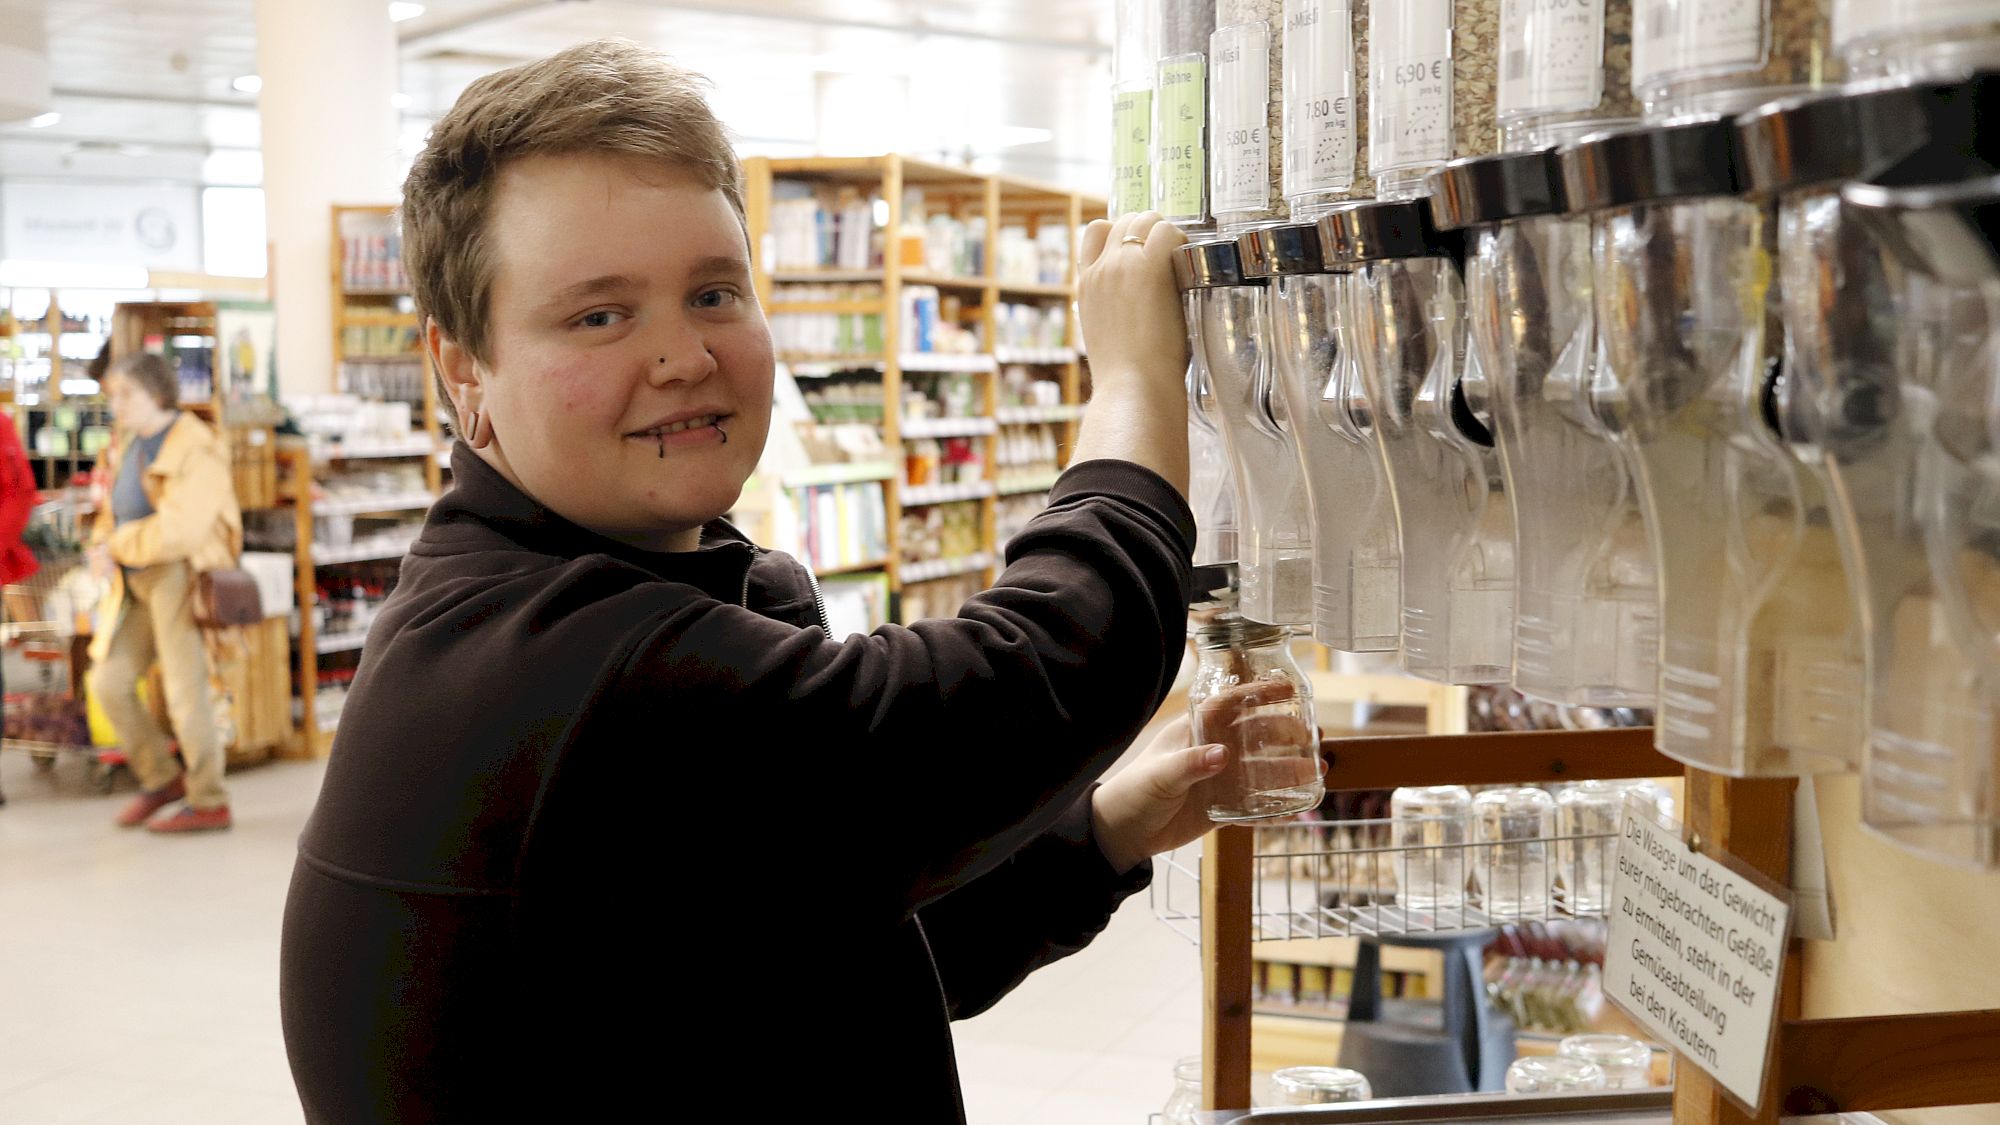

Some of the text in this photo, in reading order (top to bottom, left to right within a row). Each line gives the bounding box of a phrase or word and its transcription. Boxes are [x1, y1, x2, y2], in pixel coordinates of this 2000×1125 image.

[1395, 62, 1425, 88] 6,90
[1431, 60, 1442, 80] €
[1420, 84, 1442, 97] pro kg
[1305, 97, 1345, 121] 7,80 €
[1184, 145, 1192, 159] €
[1227, 128, 1260, 148] 5,80 €
[1136, 165, 1144, 178] €
[1626, 817, 1776, 936] Die Waage um das Gewicht
[1619, 856, 1773, 978] eurer mitgebrachten Gefäße
[1623, 896, 1755, 1006] zu ermitteln, steht in der
[1632, 938, 1726, 1036] Gemüseabteilung
[1629, 973, 1718, 1069] bei den Kräutern.
